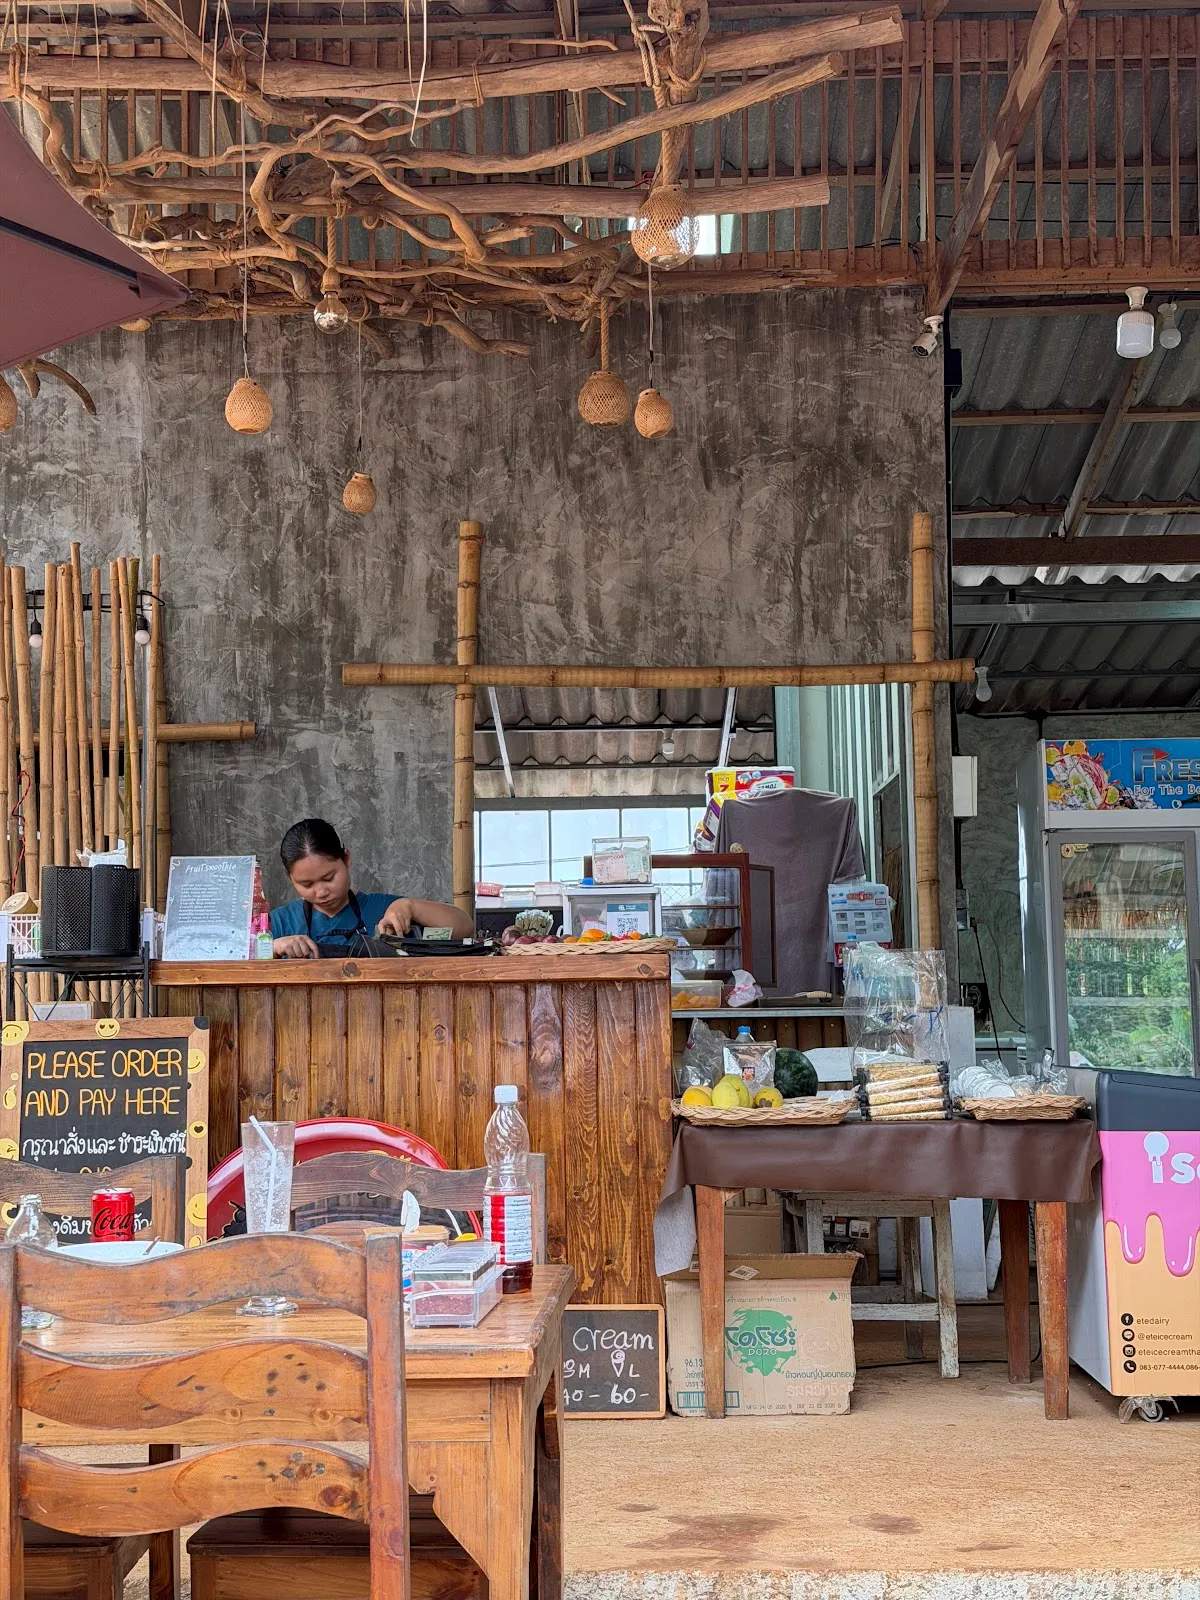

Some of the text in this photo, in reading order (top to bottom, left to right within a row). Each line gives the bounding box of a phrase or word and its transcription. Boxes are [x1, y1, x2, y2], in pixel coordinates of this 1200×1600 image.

[1134, 785, 1155, 796] For
[1158, 785, 1183, 795] The
[27, 1048, 183, 1079] PLEASE ORDER
[24, 1086, 182, 1117] AND PAY HERE
[1136, 1316, 1170, 1326] etedairy
[573, 1326, 654, 1352] Cream
[1138, 1332, 1193, 1341] @eteicecream
[579, 1362, 640, 1378] M L
